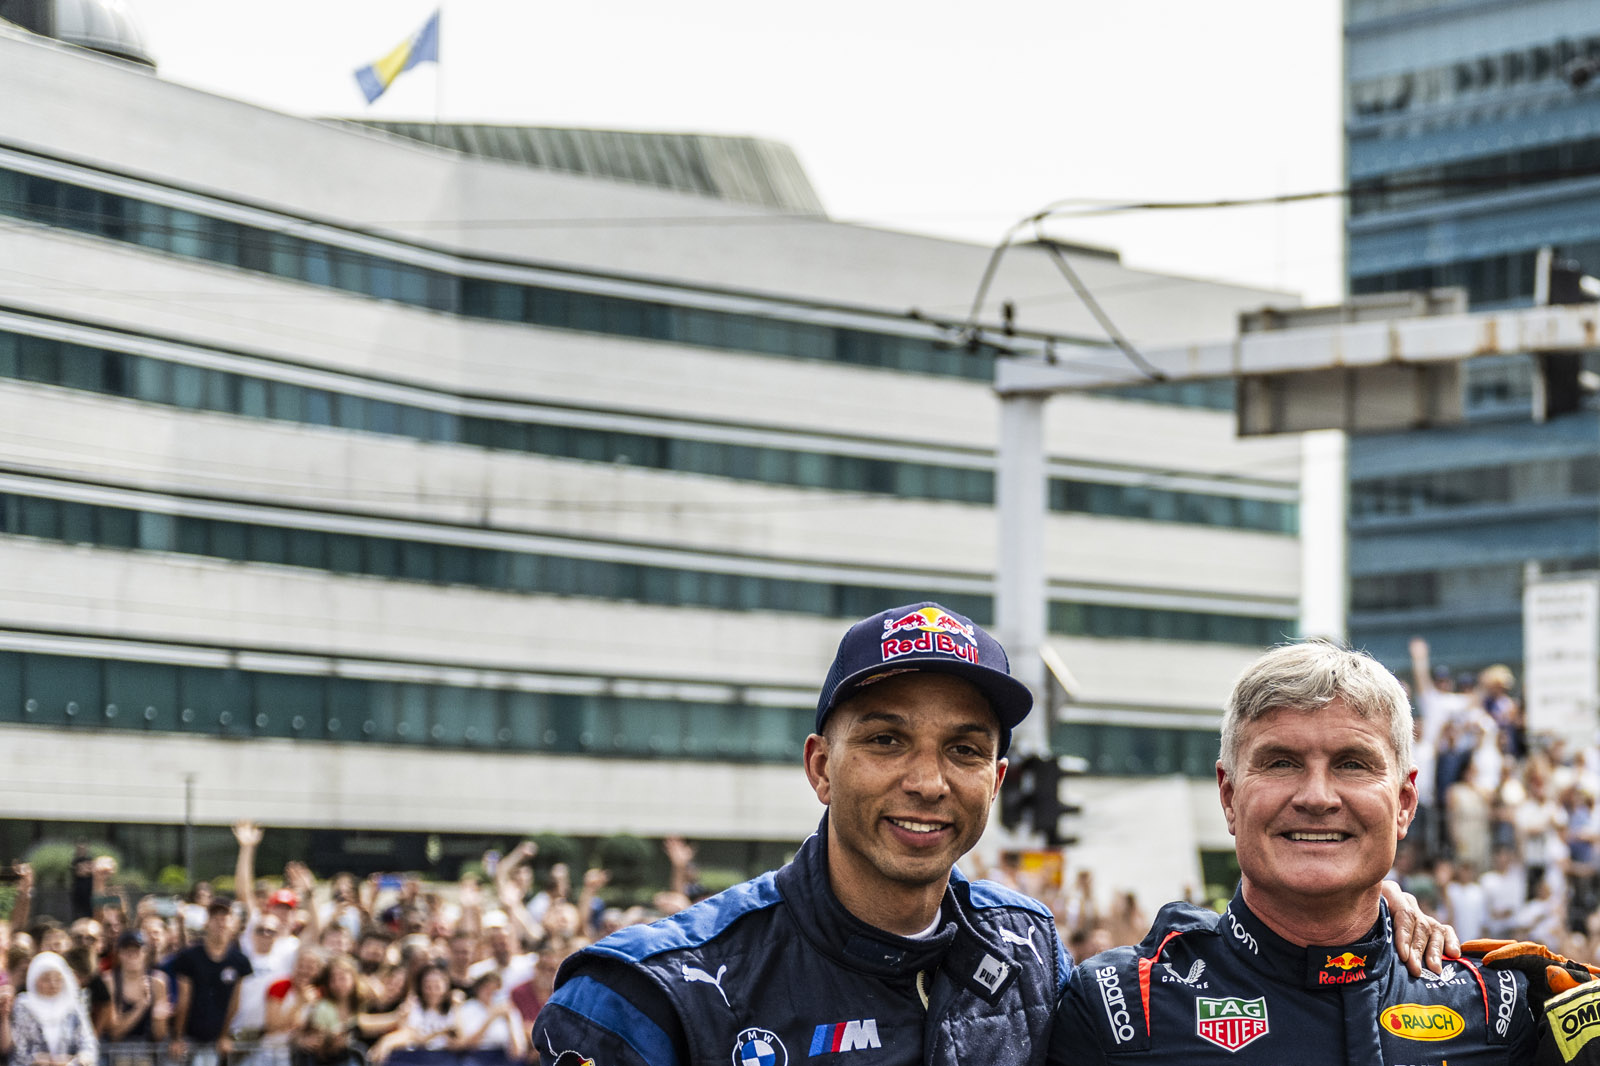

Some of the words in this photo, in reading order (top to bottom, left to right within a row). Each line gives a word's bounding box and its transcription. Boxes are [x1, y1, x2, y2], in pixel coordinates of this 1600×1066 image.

[882, 632, 933, 662] Red
[936, 633, 979, 664] Bull
[1319, 970, 1346, 985] Red
[1345, 969, 1367, 984] Bull
[1096, 966, 1135, 1043] sparco
[1202, 1000, 1264, 1019] TAG
[1200, 1019, 1266, 1049] HEUER
[1402, 1014, 1455, 1031] RAUCH
